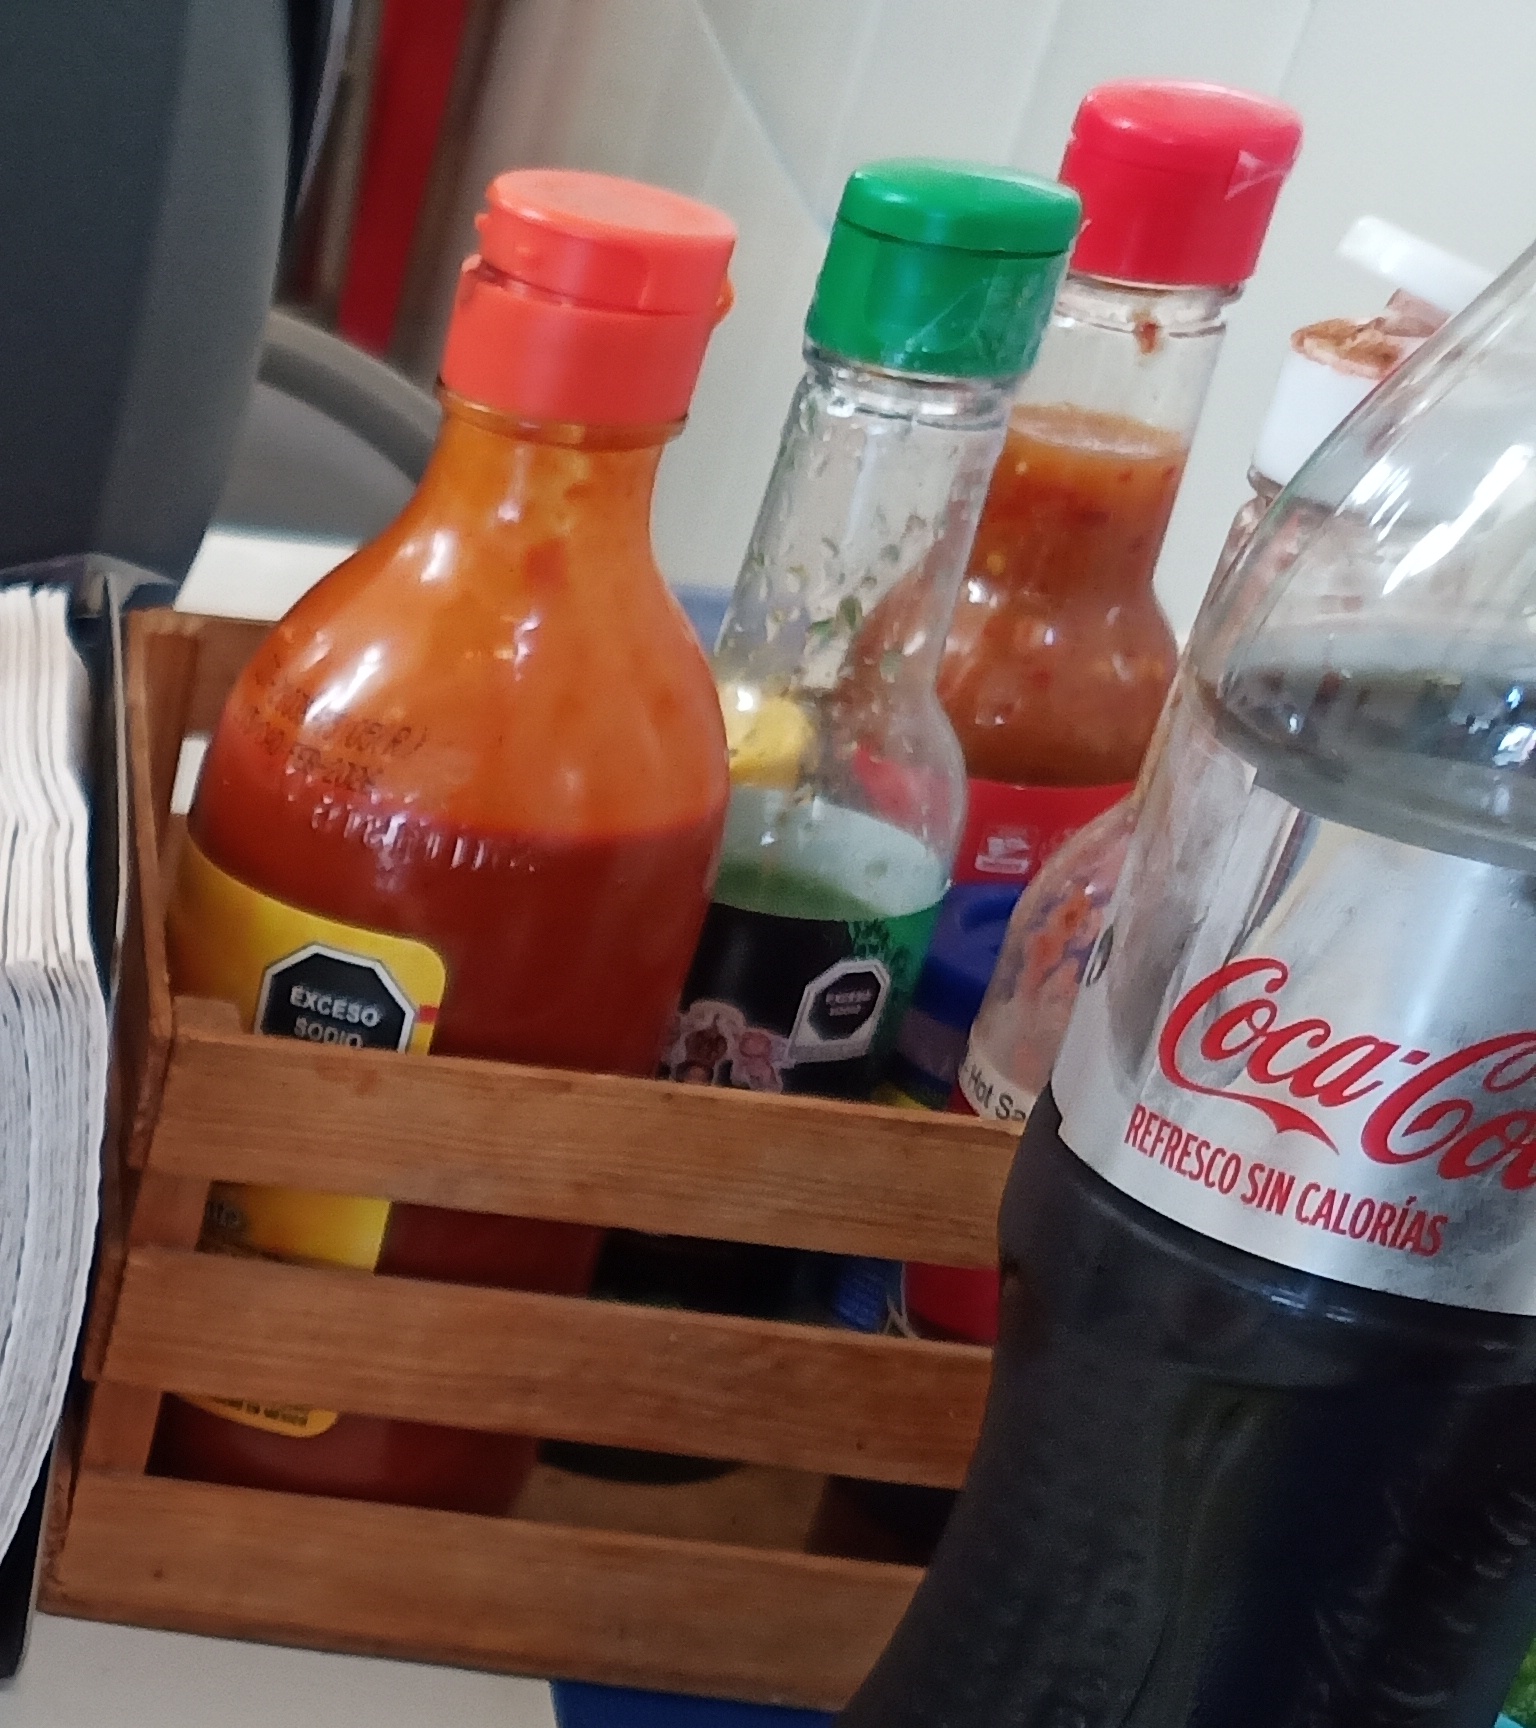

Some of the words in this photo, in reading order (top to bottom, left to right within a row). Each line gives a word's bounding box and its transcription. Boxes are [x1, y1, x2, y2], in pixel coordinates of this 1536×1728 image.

[289, 984, 381, 1028] EXCESO
[293, 1015, 364, 1048] SODIO
[969, 1064, 994, 1109] Hot
[1124, 1103, 1242, 1194] REFRESCO
[1242, 1162, 1297, 1216] SIN
[1295, 1182, 1449, 1258] CALORÍAS
